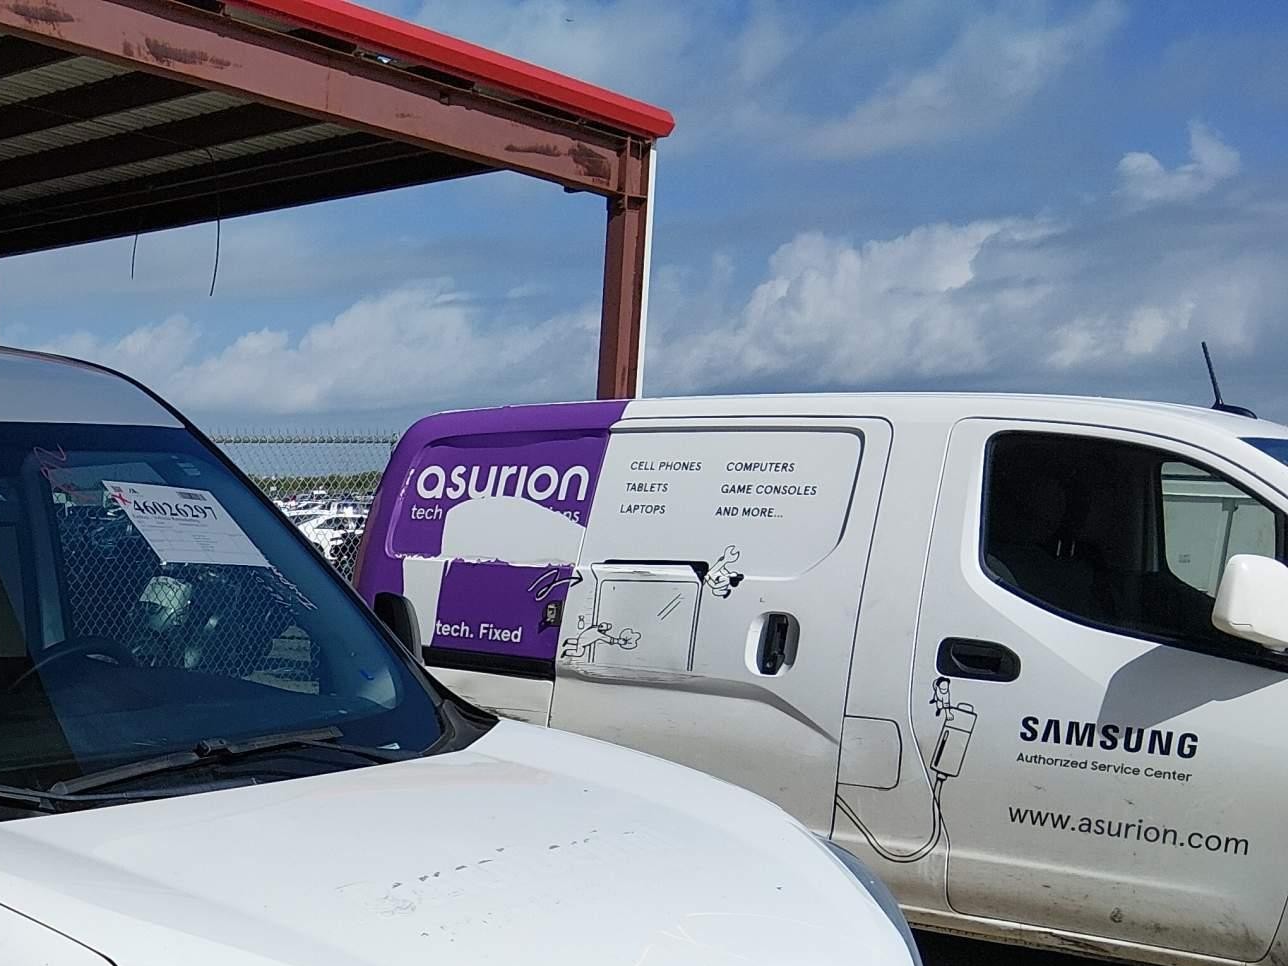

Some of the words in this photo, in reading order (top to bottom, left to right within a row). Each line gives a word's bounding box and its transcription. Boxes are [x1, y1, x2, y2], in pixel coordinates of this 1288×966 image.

[630, 461, 655, 471] CELL
[659, 461, 702, 472] PHONES
[726, 462, 795, 473] COMPUTERS
[417, 465, 589, 501] asurion
[626, 483, 668, 493] TABLETS
[721, 484, 753, 495] GAME
[756, 484, 817, 496] CONSOLES
[133, 500, 218, 521] 46026297
[411, 504, 443, 520] tech
[620, 504, 666, 515] LAPTOPS
[715, 506, 739, 517] AND
[741, 507, 784, 519] MORE...
[436, 620, 474, 638] tech.
[479, 623, 522, 643] Fixed
[1020, 716, 1199, 760] SAMSUNG
[1016, 752, 1088, 771] Authorized
[1091, 760, 1141, 777] Service
[1144, 767, 1193, 783] Center
[1008, 806, 1250, 857] www.asurion.com
